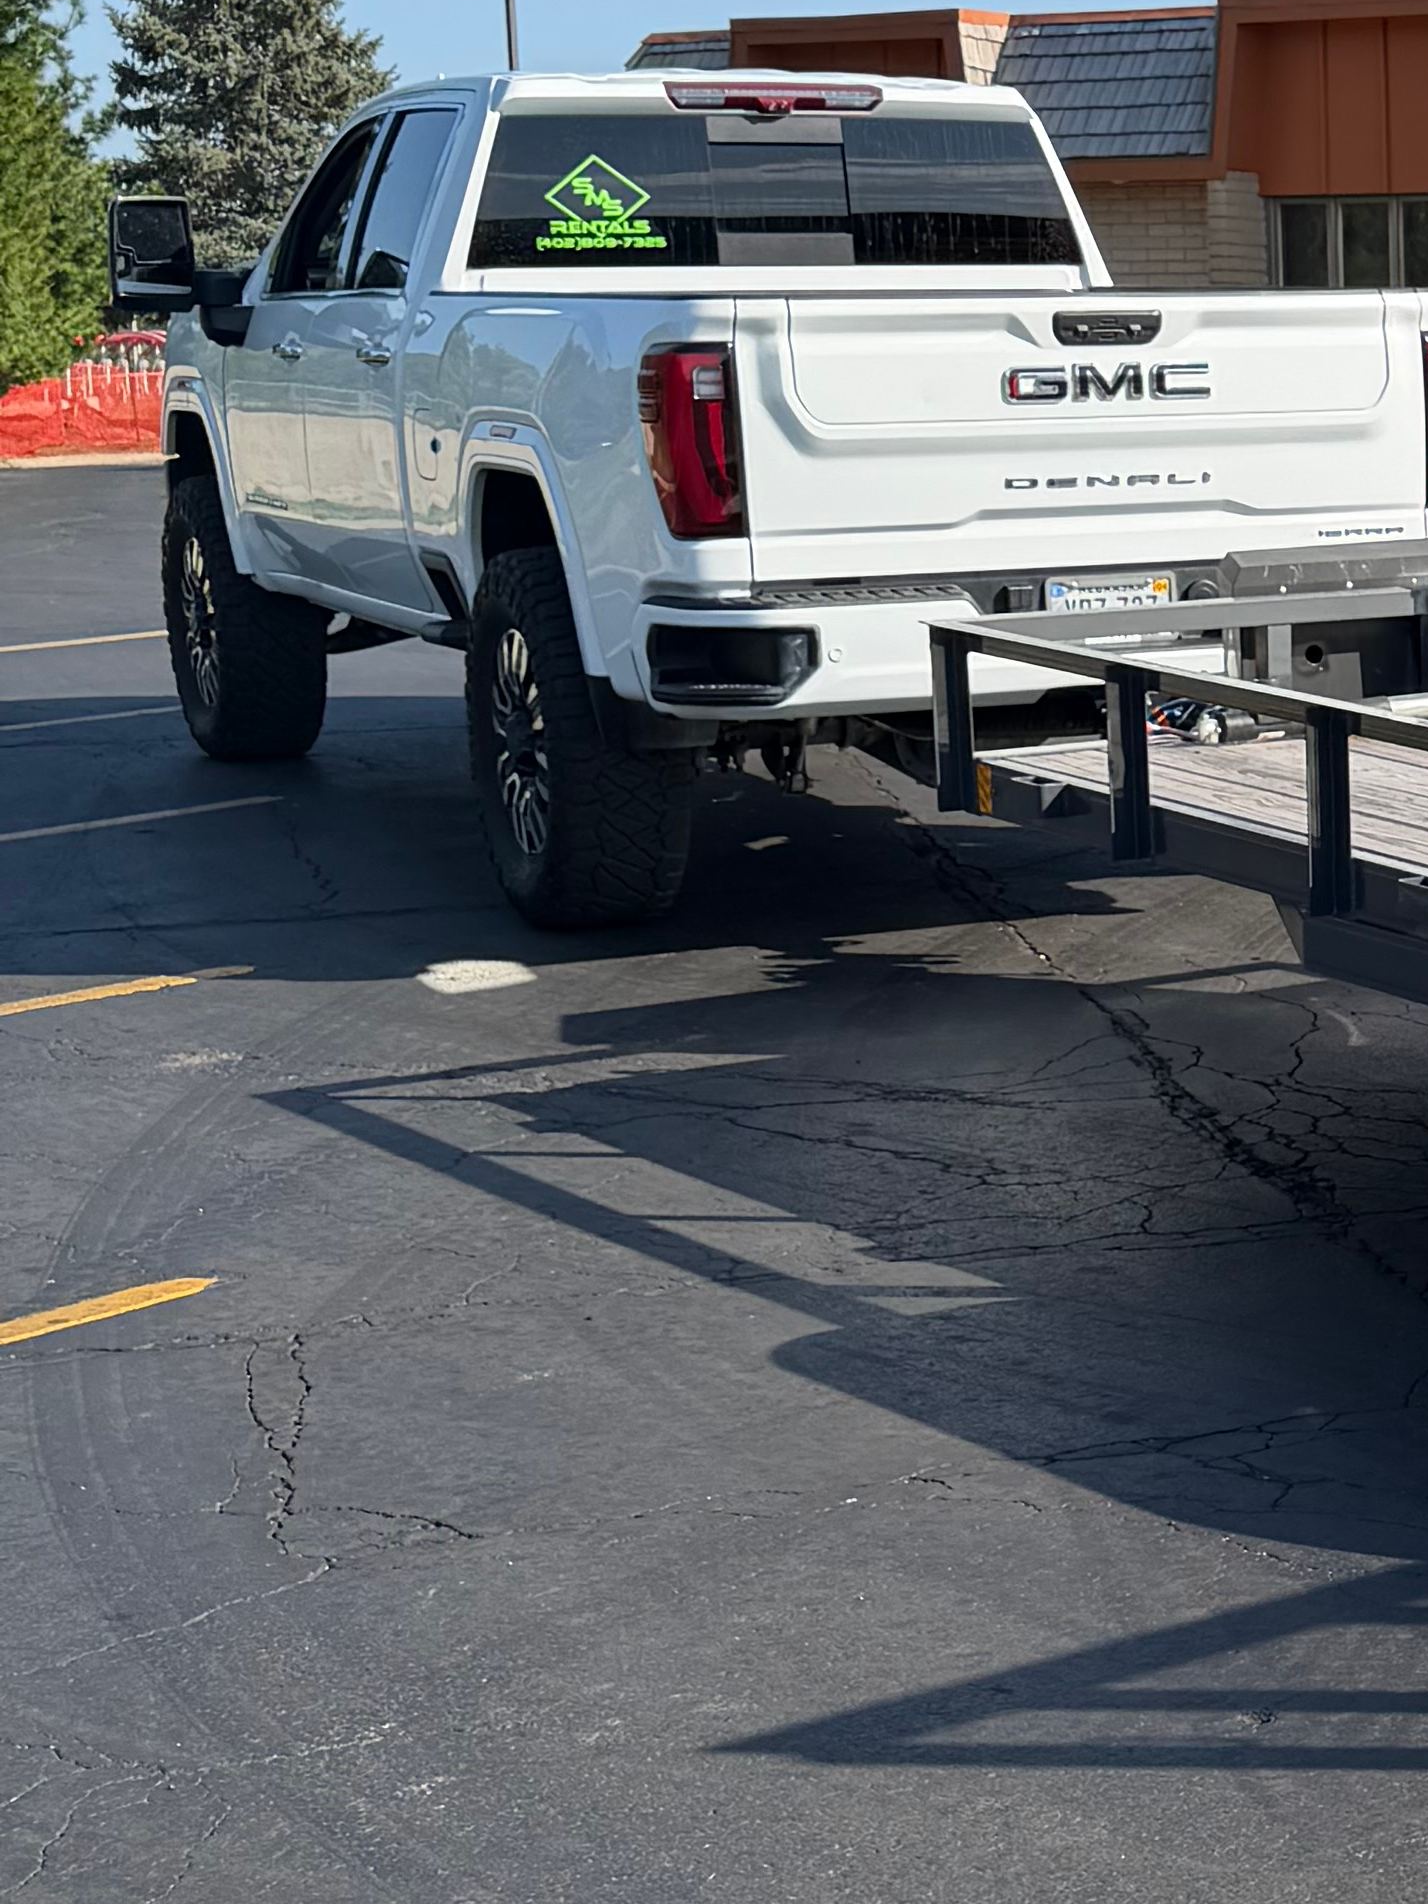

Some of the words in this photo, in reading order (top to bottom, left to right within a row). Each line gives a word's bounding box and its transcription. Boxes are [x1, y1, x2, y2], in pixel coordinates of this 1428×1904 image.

[571, 177, 624, 216] SMS
[549, 220, 651, 234] RENTALS
[536, 236, 667, 251] (402)809-7325
[1001, 362, 1211, 406] GMC
[1004, 471, 1212, 490] DENALI
